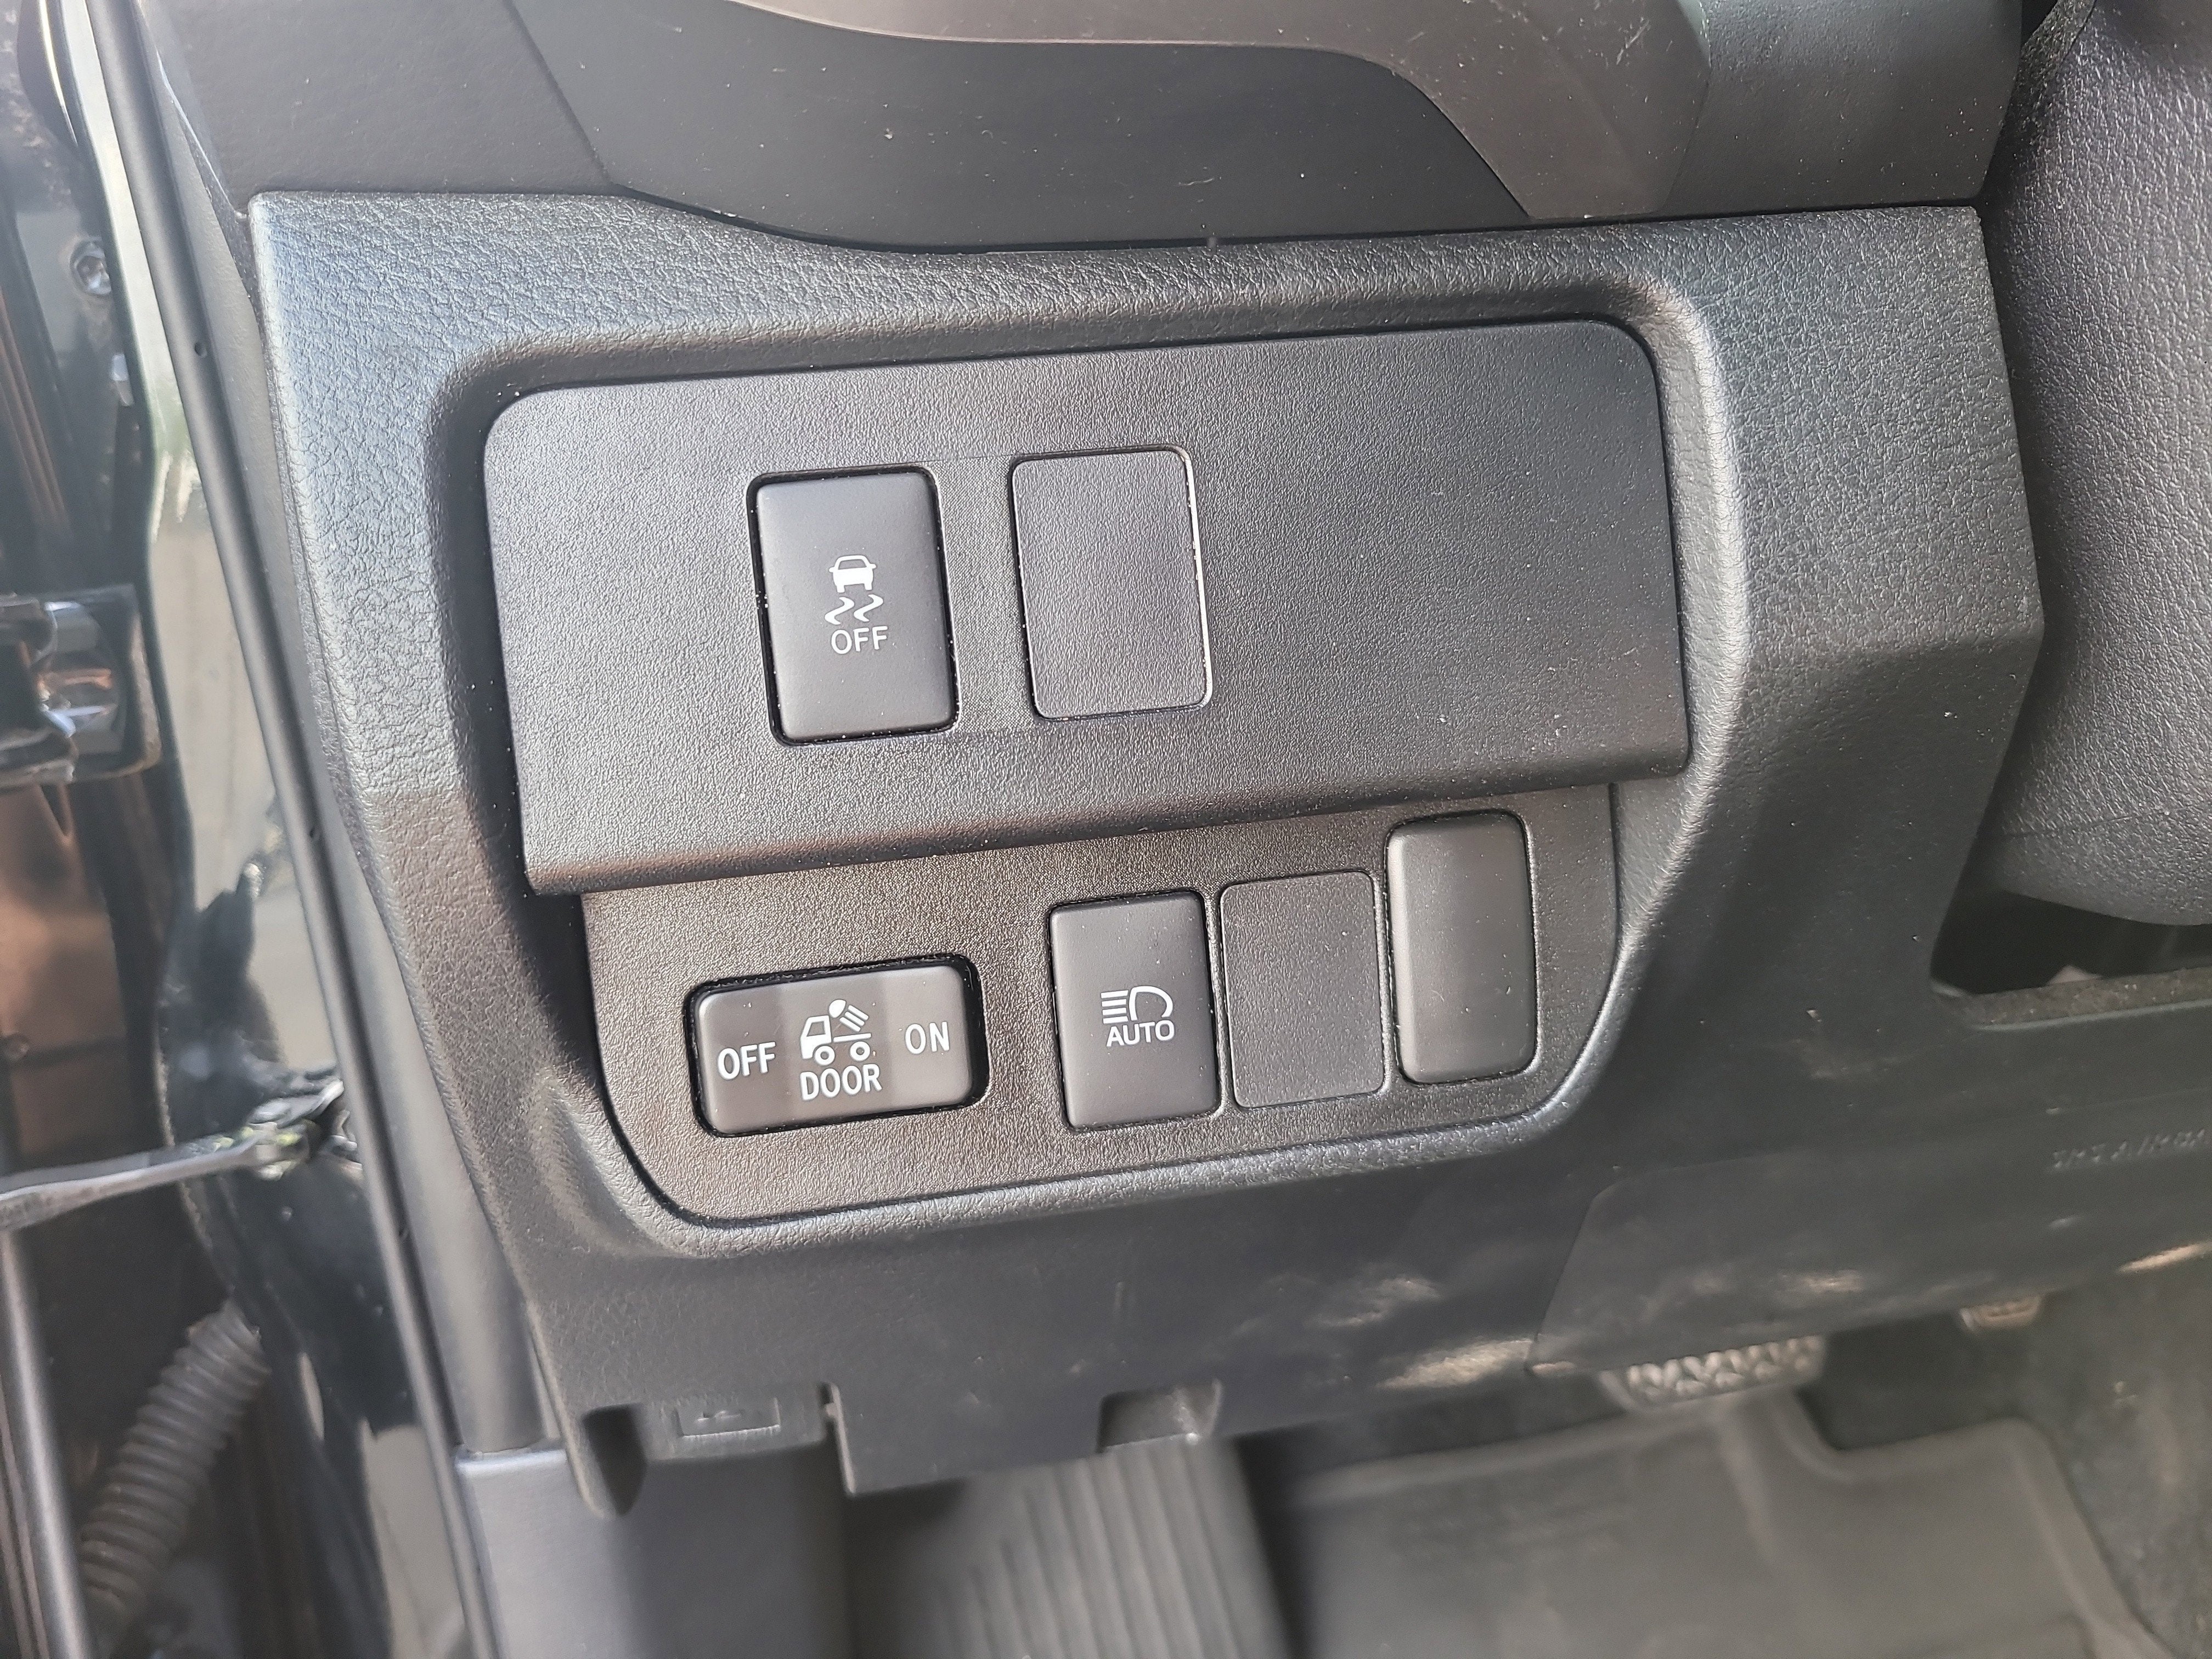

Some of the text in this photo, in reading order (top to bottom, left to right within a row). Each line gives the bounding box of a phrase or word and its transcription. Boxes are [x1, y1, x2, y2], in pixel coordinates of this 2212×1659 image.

[831, 625, 888, 654] OFF
[905, 1022, 950, 1054] ON
[1106, 1020, 1175, 1047] AUTO
[717, 1042, 776, 1080] OFF
[800, 1064, 882, 1101] DOOR
